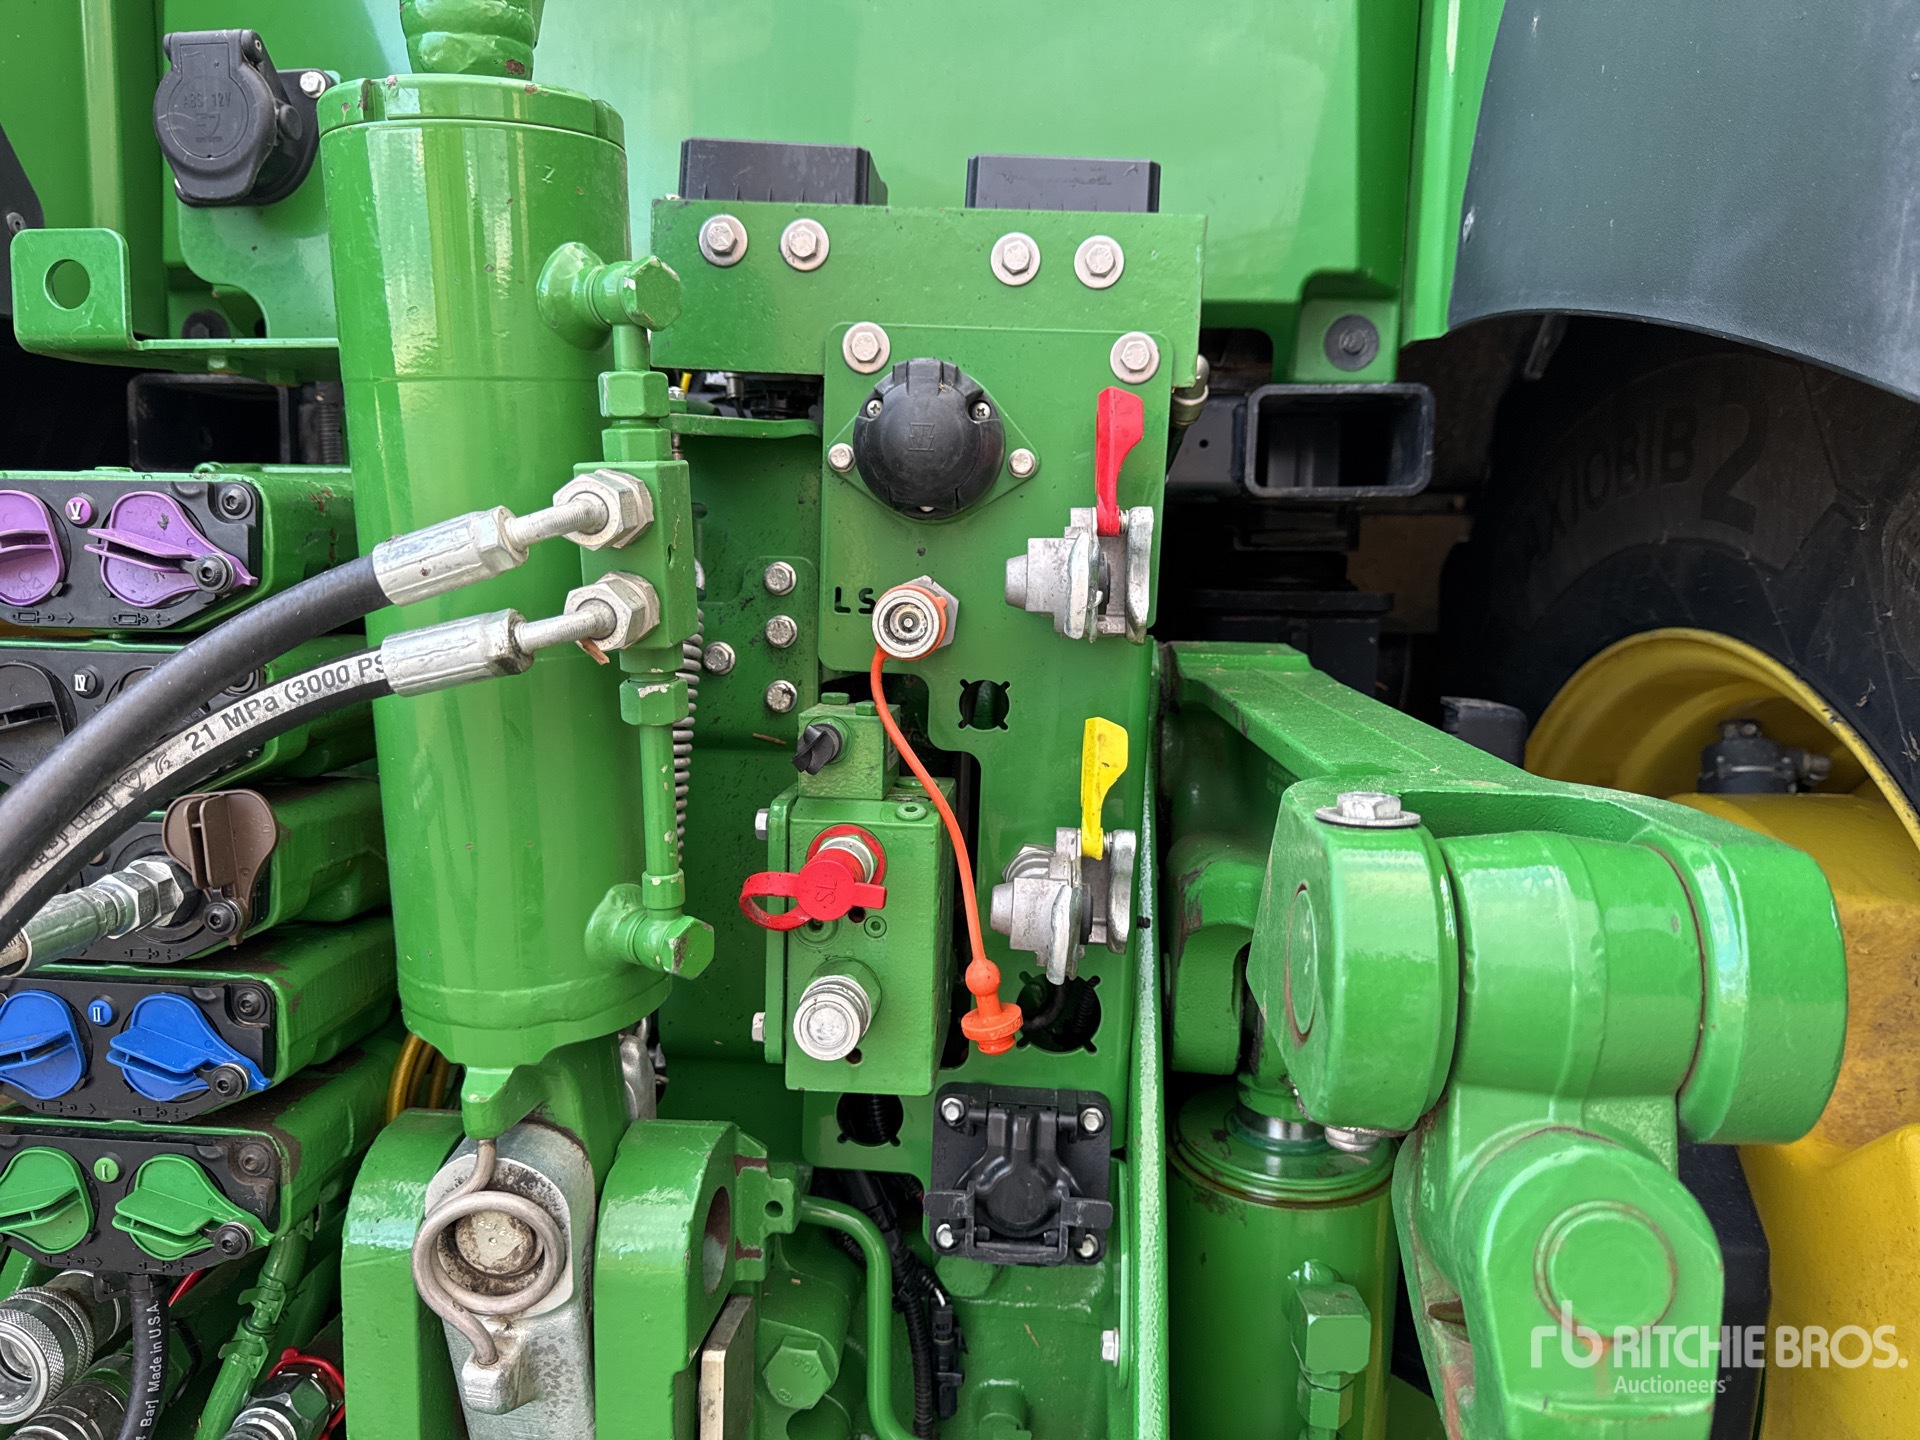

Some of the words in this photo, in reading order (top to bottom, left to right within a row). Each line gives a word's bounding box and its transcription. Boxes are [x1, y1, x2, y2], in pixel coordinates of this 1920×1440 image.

[70, 501, 84, 520] V
[834, 586, 877, 614] LS
[185, 724, 217, 752] 21
[220, 694, 280, 731] MPa
[284, 664, 351, 703] (3000
[146, 1300, 162, 1339] U.S.A.
[150, 1340, 162, 1354] in
[147, 1356, 162, 1393] Made
[140, 1399, 159, 1427] Bar]
